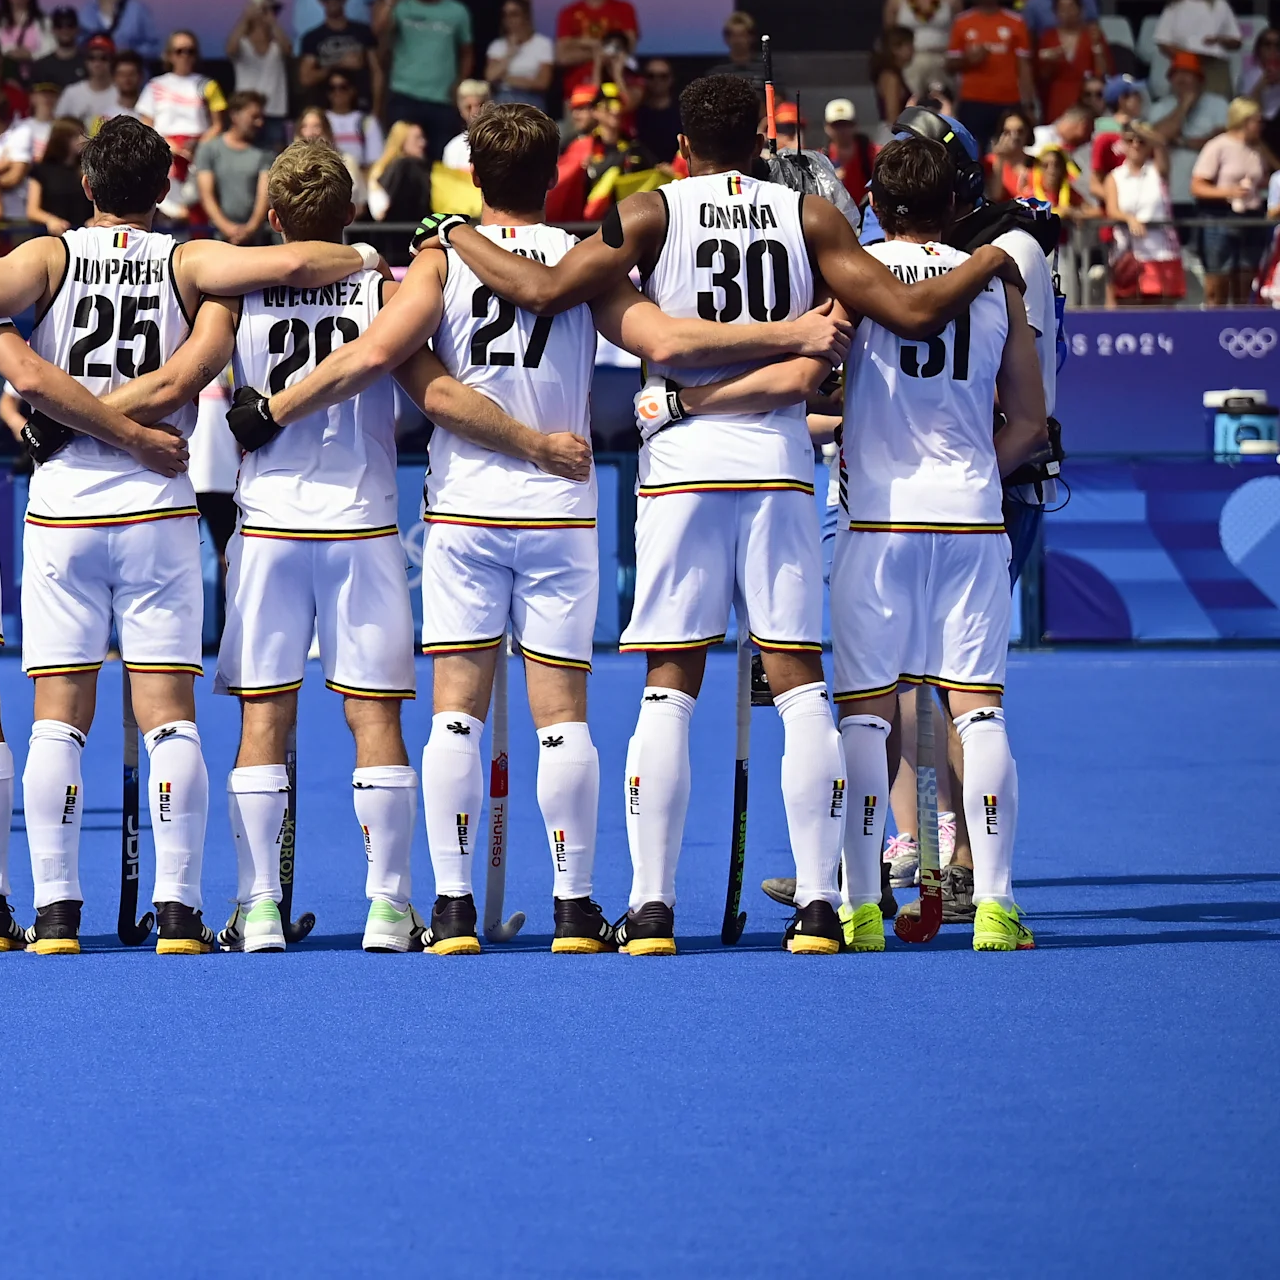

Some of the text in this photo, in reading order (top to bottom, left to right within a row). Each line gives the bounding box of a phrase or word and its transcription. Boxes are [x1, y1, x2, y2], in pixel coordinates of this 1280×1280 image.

[699, 202, 777, 230] ONANA
[696, 238, 791, 323] 30
[263, 283, 363, 309] WEGNEZ
[69, 294, 161, 379] 25
[1096, 332, 1174, 357] 2024
[62, 794, 76, 825] BEL
[160, 793, 172, 823] BEL
[630, 784, 641, 815] BEL
[830, 790, 844, 818] BEL
[491, 803, 503, 868] THURSO
[864, 806, 875, 837] BEL
[986, 807, 998, 836] BEL
[457, 826, 469, 856] BEL
[557, 843, 567, 873] BEL
